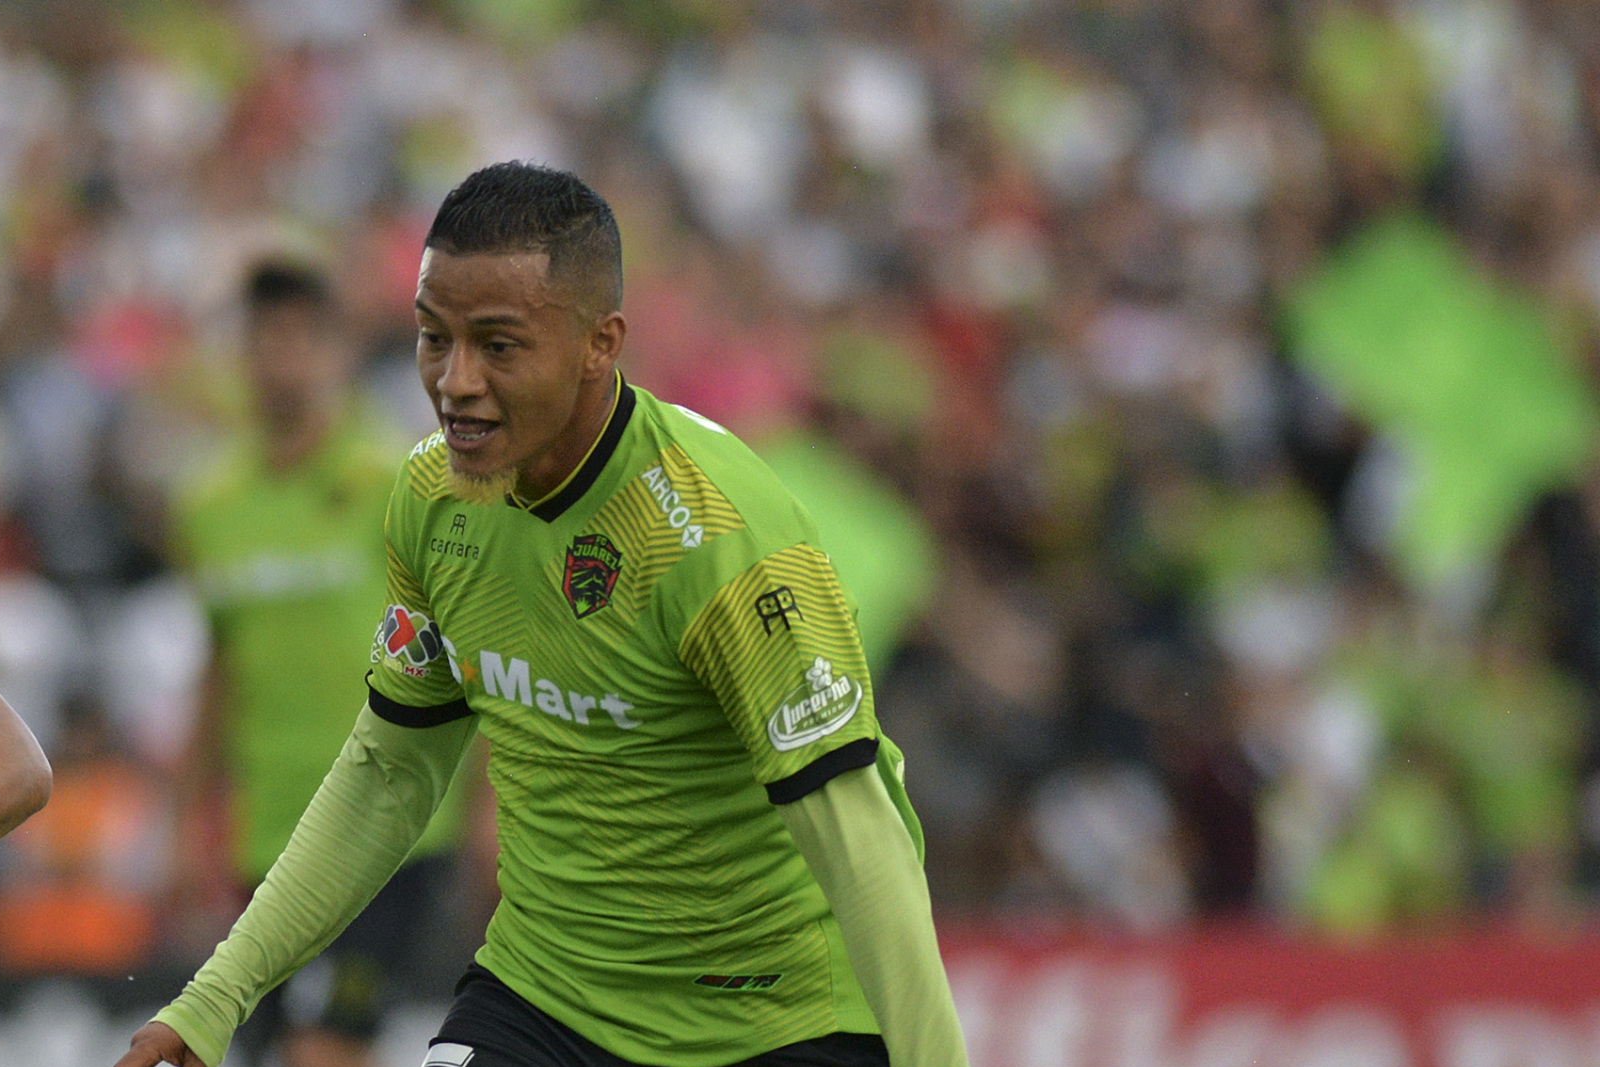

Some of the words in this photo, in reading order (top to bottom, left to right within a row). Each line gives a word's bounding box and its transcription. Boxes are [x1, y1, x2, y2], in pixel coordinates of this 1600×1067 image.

[641, 466, 690, 528] ARCO
[431, 538, 480, 560] carrara
[404, 666, 425, 678] MX
[480, 650, 643, 730] Mart
[782, 675, 852, 735] Lucerna
